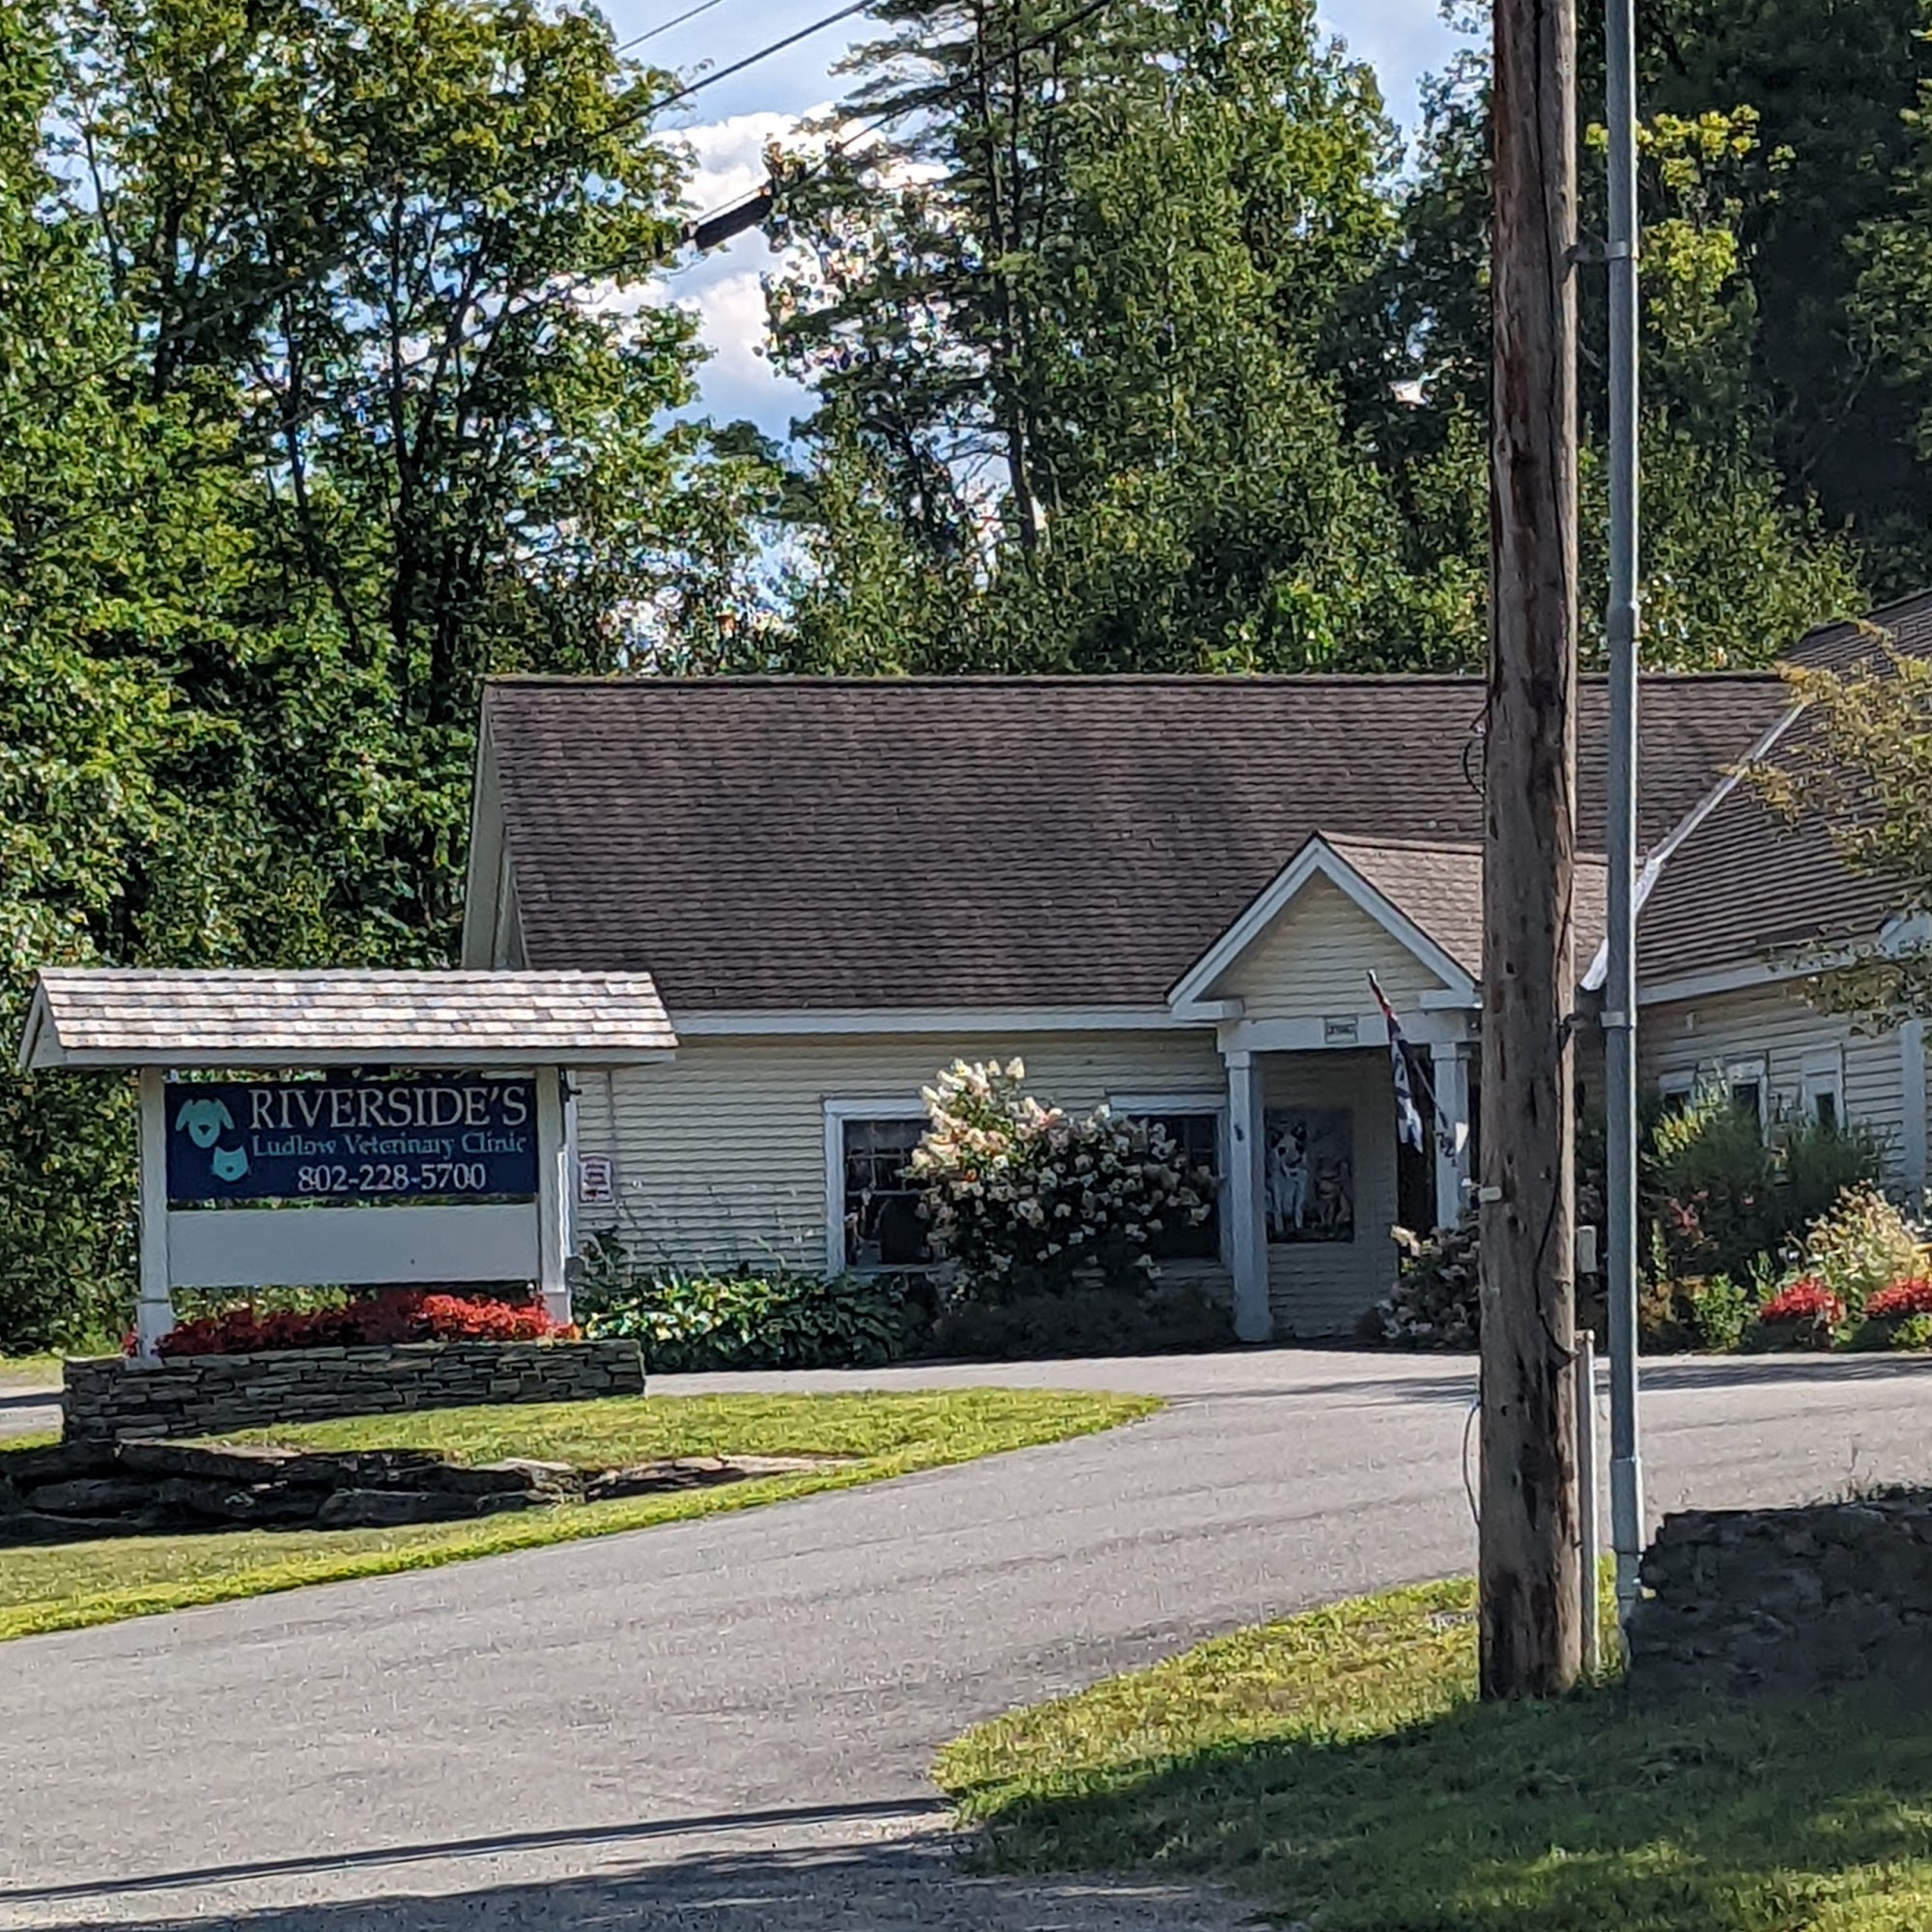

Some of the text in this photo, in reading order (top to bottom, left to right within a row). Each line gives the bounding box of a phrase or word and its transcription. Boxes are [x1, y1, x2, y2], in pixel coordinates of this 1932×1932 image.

[248, 1086, 527, 1129] RIVERSIDE'S
[252, 1131, 526, 1160] Ludlow Veterinary Clinic
[298, 1163, 486, 1192] 802-228-5700
